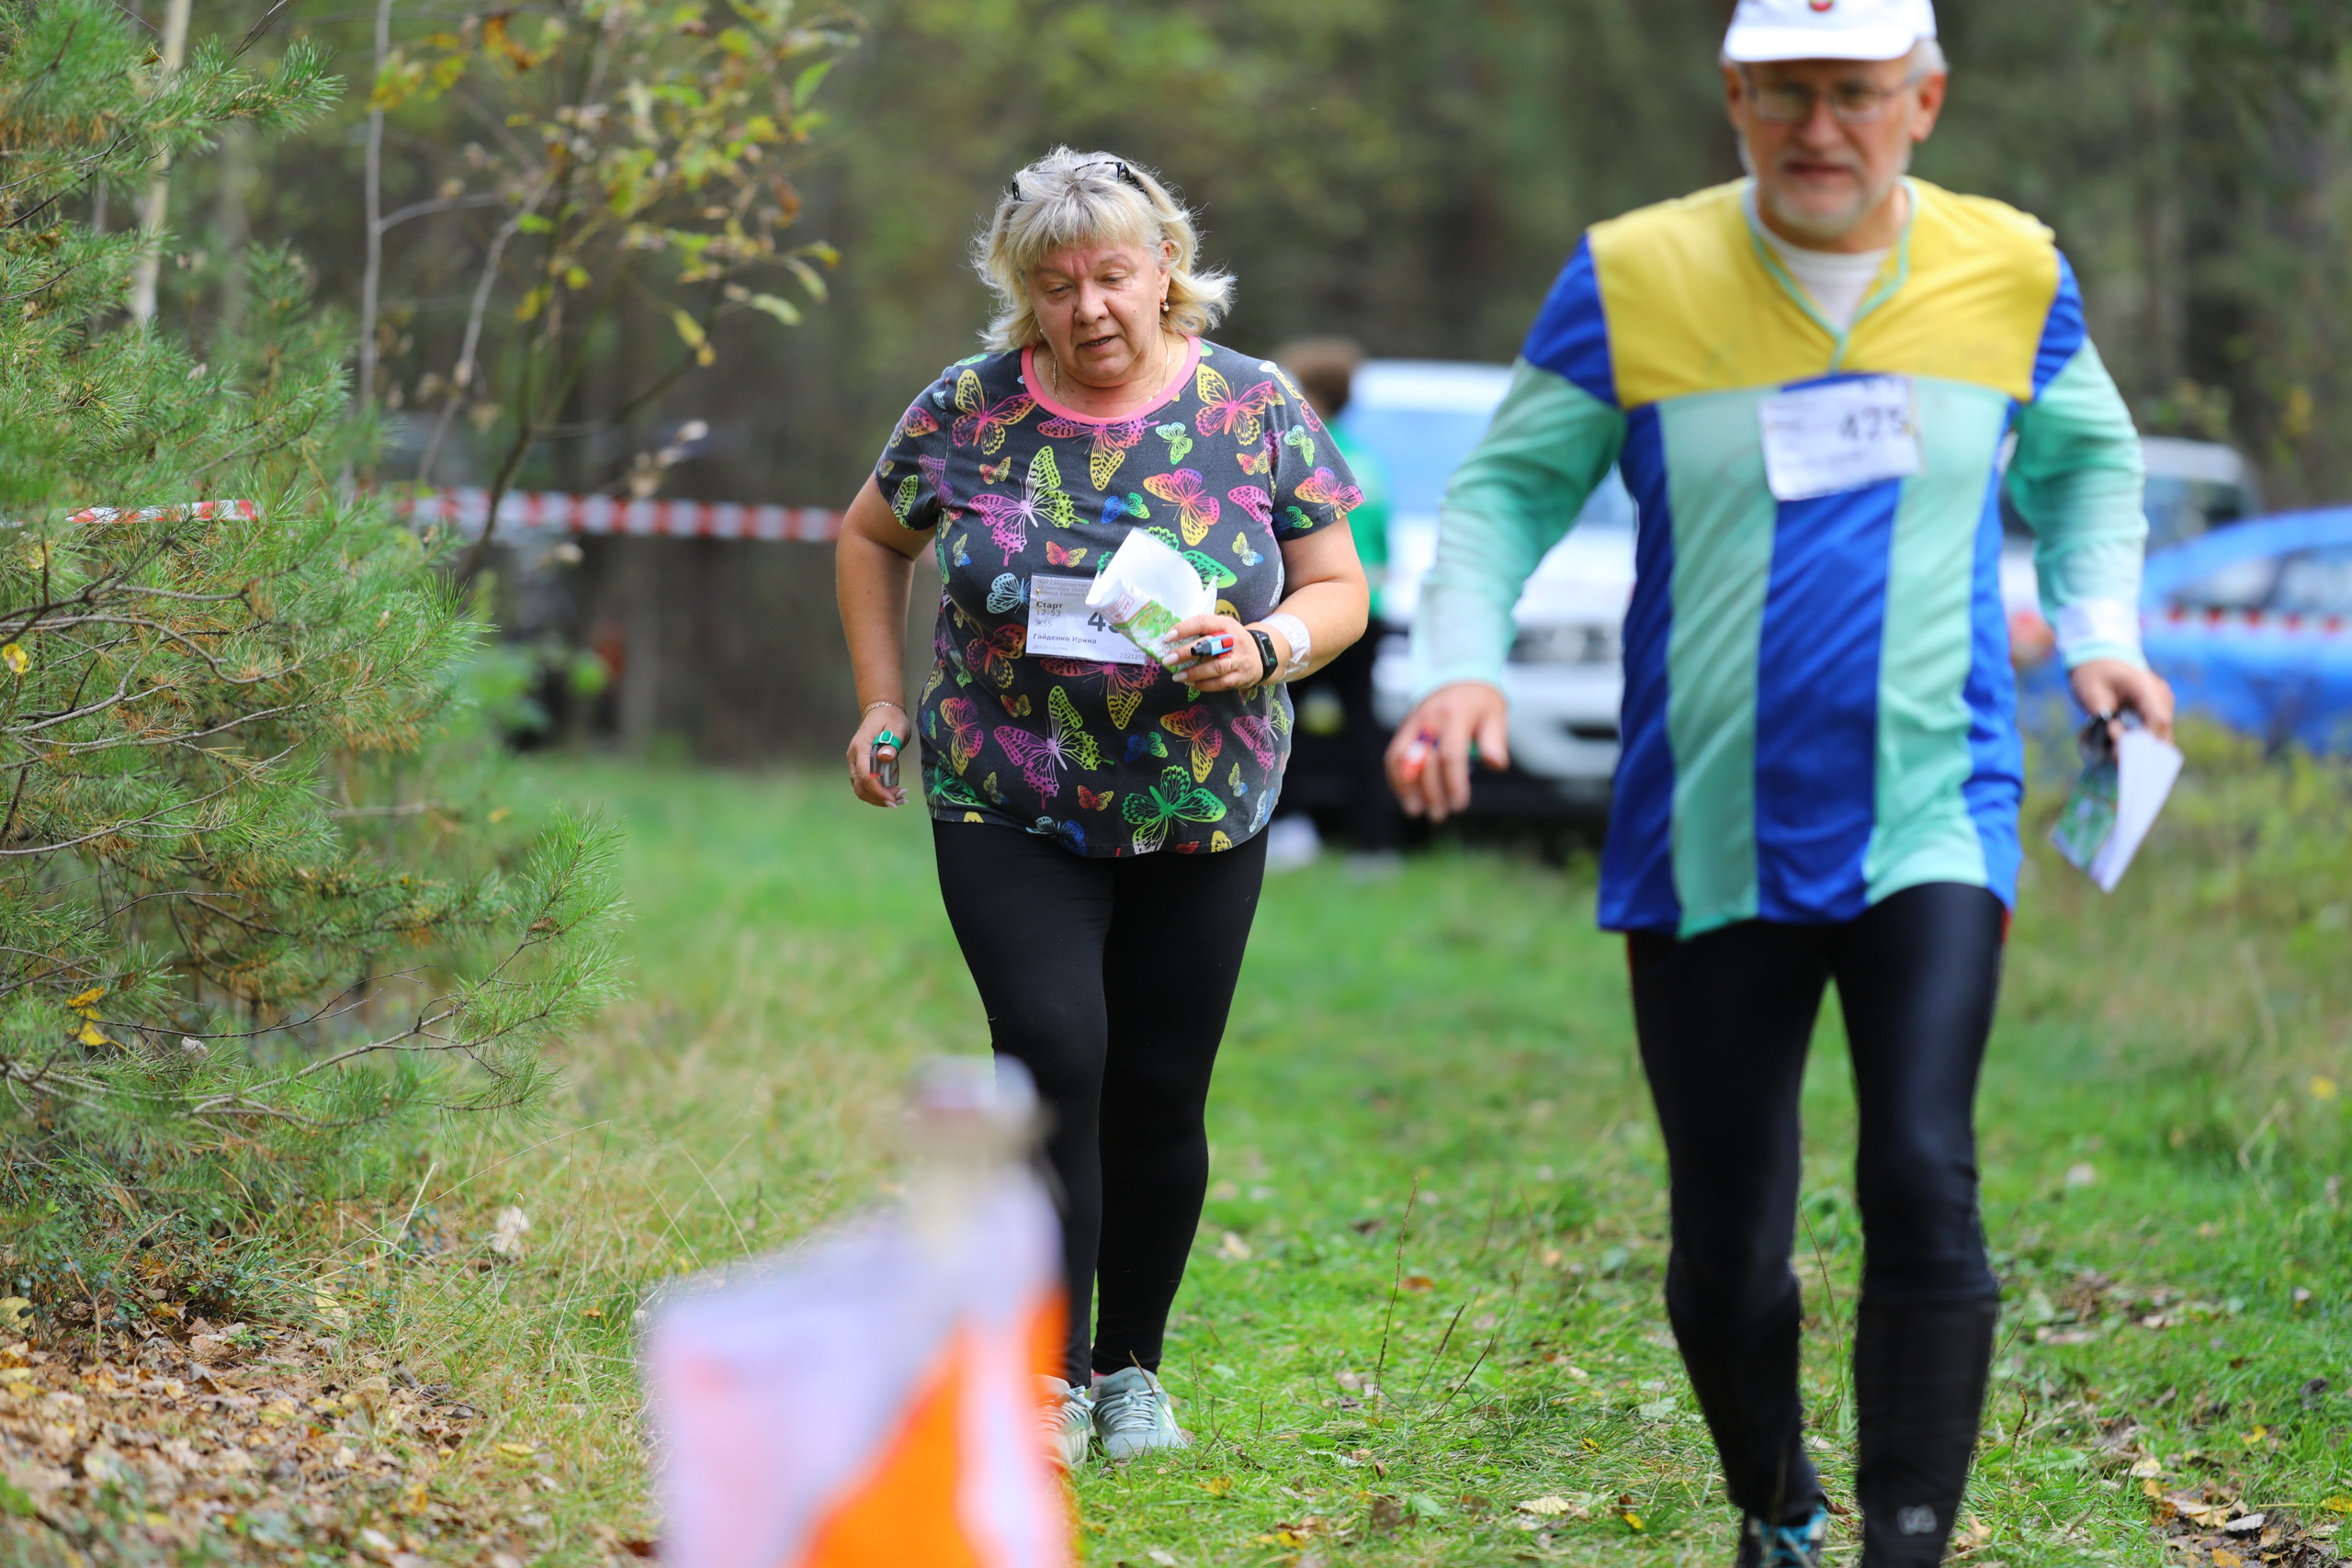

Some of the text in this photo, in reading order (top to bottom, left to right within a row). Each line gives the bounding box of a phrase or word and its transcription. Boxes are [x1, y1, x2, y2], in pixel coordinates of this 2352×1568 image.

[1035, 601, 1063, 610] Старт
[1036, 608, 1061, 617] 12:53
[1035, 619, 1053, 627] Ж55
[1087, 610, 1121, 634] 4
[1033, 633, 1097, 645] Гайденко Ирина
